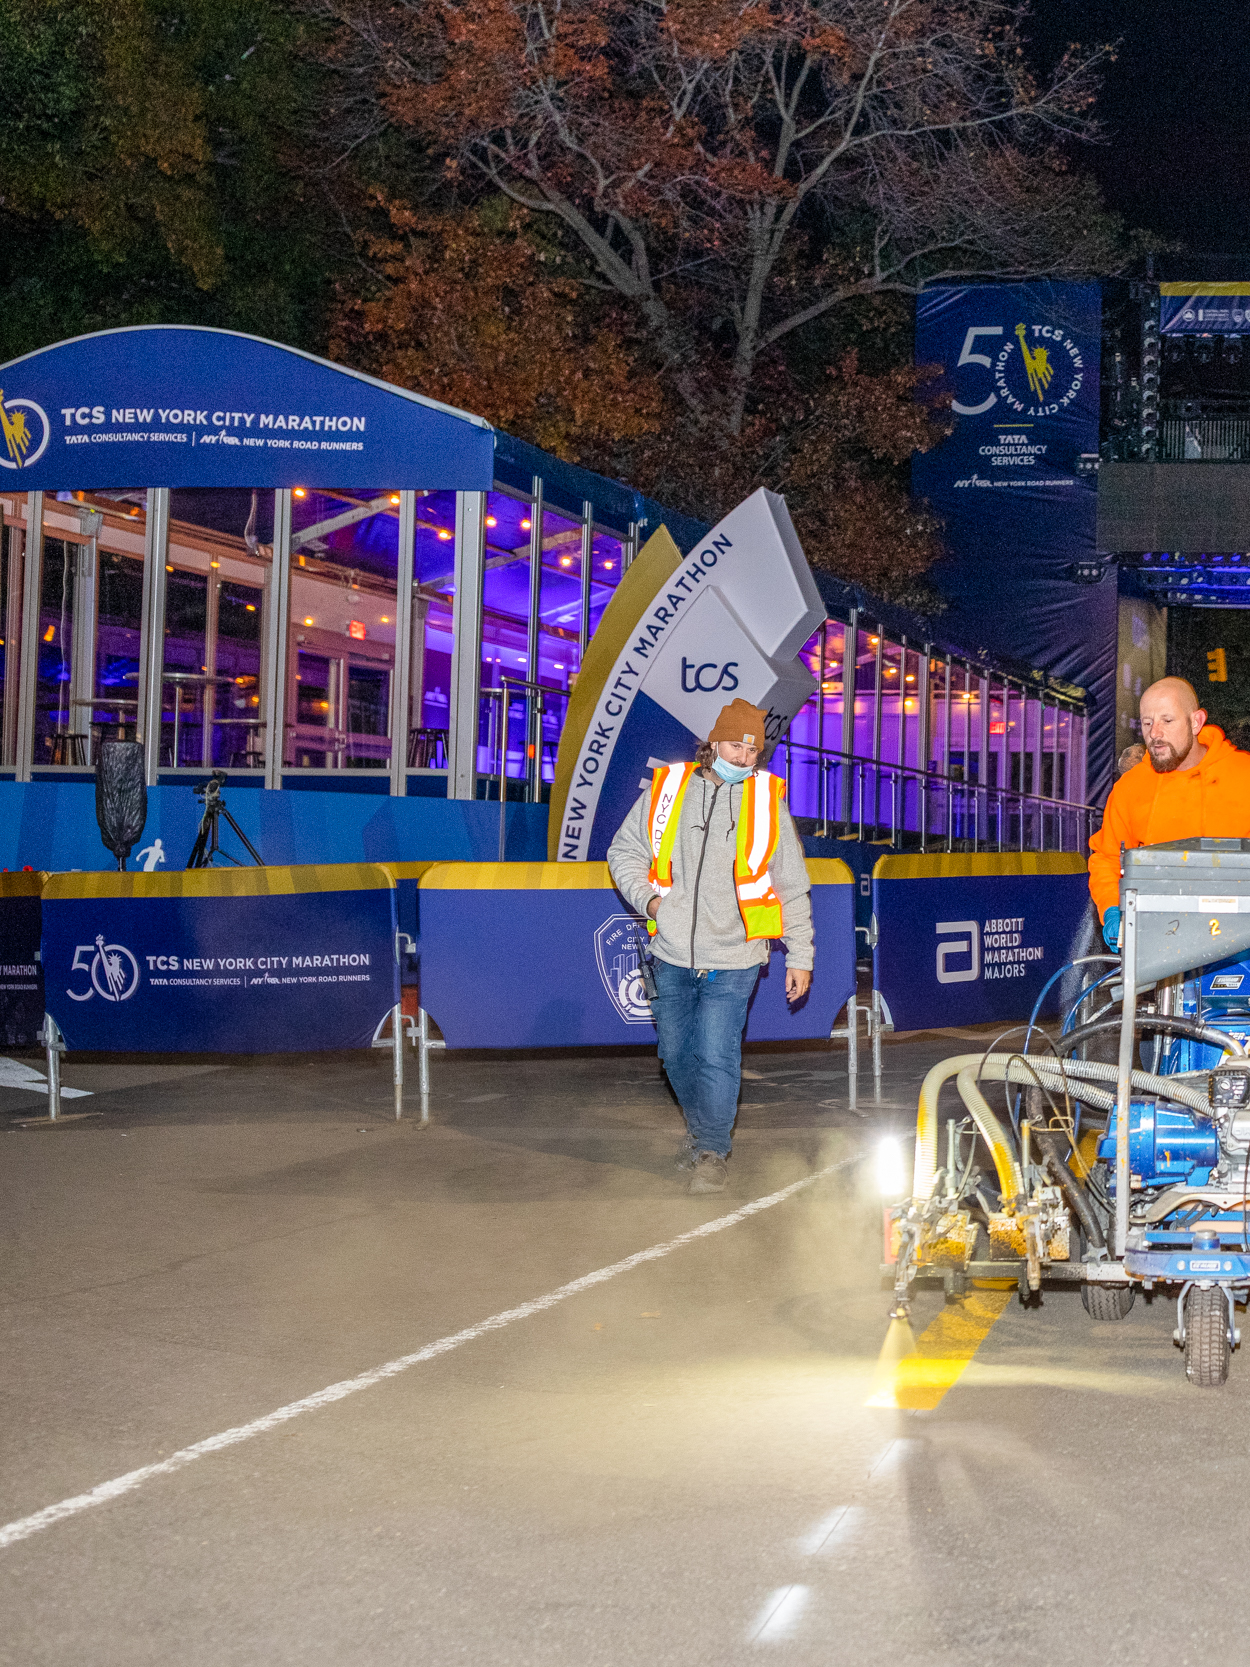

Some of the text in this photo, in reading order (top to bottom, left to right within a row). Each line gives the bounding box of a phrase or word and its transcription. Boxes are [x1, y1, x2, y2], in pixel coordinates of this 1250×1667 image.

[995, 325, 1084, 416] TCS NEW YORK CITY MARATHON
[61, 406, 366, 432] TCS NEW YORK CITY MARATHON
[65, 435, 89, 444] TATA
[91, 433, 149, 443] CONSULTANCY
[150, 433, 187, 443] SERVICES
[243, 438, 265, 446] NEW
[266, 439, 292, 448] YORK
[293, 441, 318, 449] ROAD
[320, 441, 364, 450] RUNNERS
[999, 435, 1028, 444] TATA
[979, 445, 1047, 455] CONSULTANCY
[991, 456, 1035, 465] SERVICES
[681, 656, 739, 693] tcs
[562, 532, 733, 861] NEW YORK CITY MARATHON
[654, 829, 663, 854] DO
[984, 917, 1025, 933] ABBOTT
[1208, 918, 1222, 936] 2
[605, 928, 623, 946] FIRE
[984, 932, 1021, 948] WORLD
[146, 954, 370, 970] TCS NEW YORK CITY MARATHON
[984, 946, 1044, 964] MARATHON
[3, 965, 37, 975] MARATHON
[318, 975, 337, 983] ROAD
[338, 974, 370, 982] RUNNERS
[984, 963, 1025, 980] MAJORS
